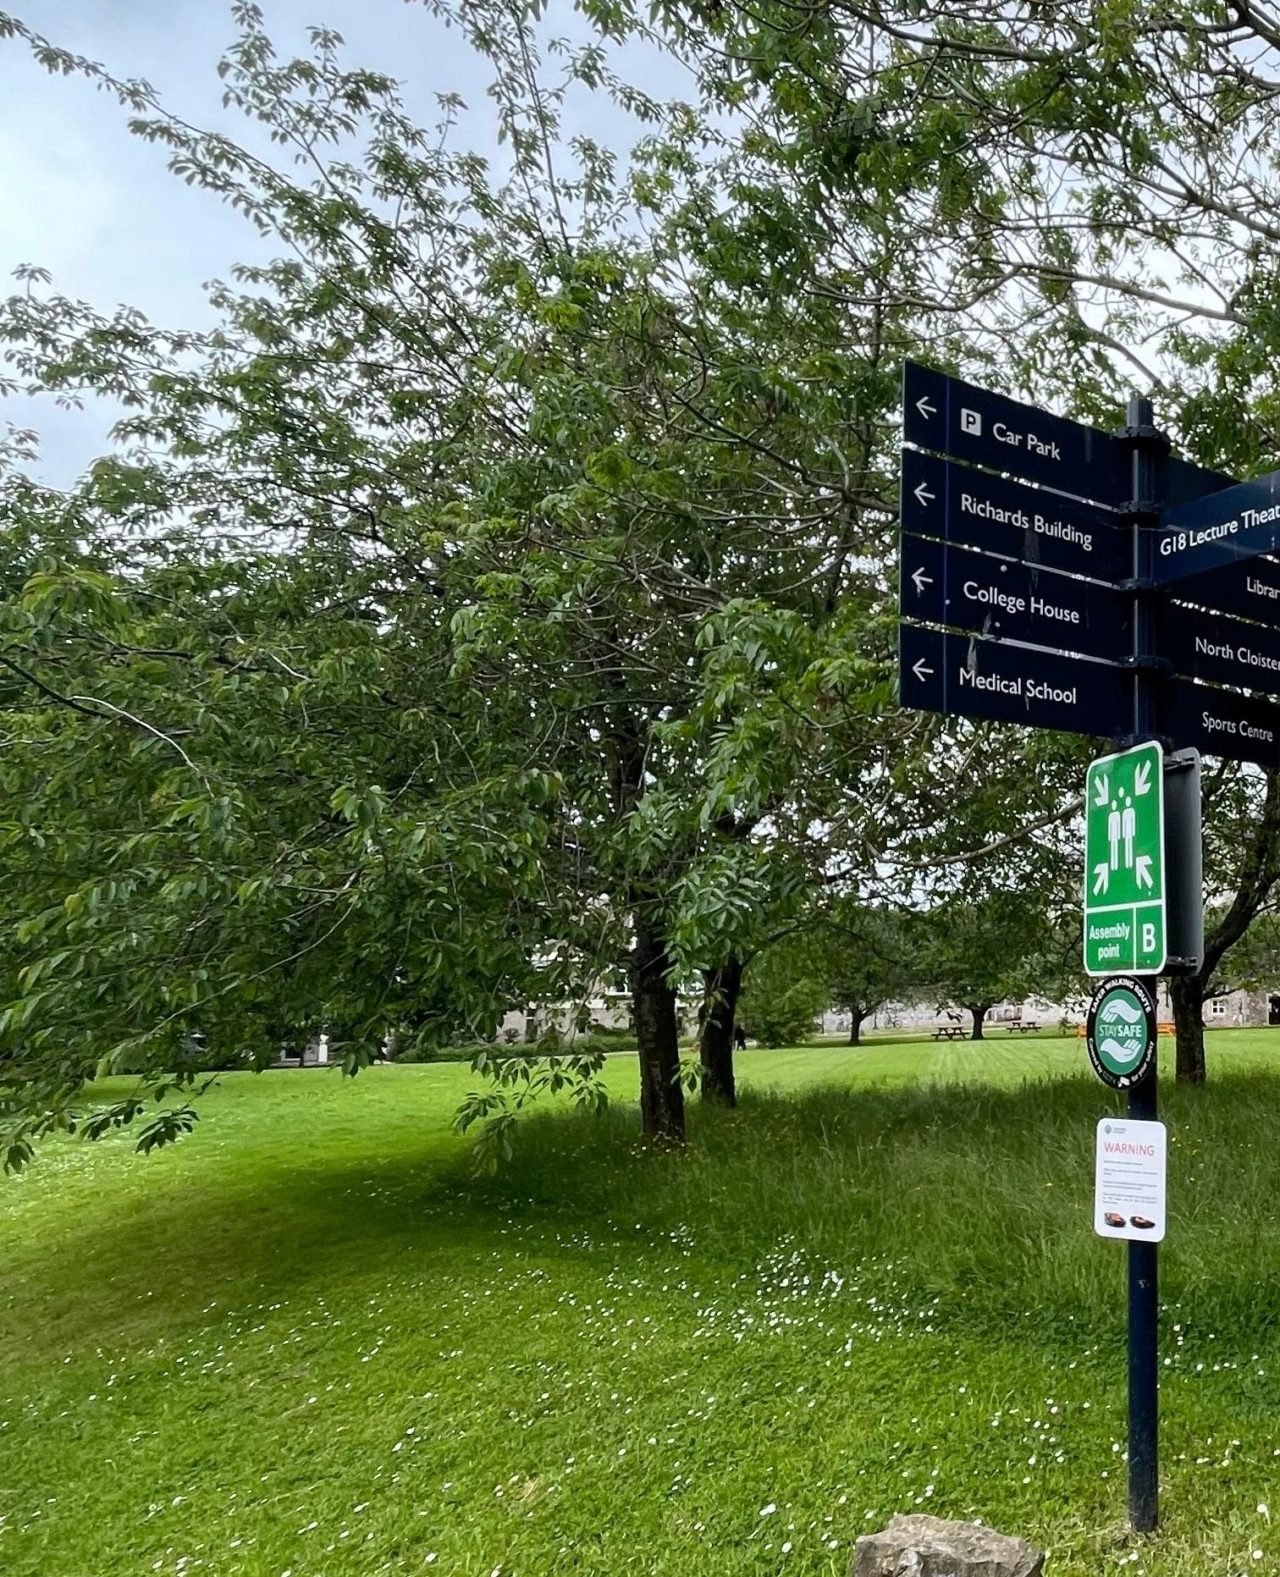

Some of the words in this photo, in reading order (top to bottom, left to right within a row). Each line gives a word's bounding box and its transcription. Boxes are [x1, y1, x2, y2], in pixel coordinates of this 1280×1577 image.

[992, 422, 1023, 446] Car
[1027, 433, 1062, 461] Park
[961, 493, 1029, 529] Richards
[1033, 514, 1093, 552] Building
[1189, 519, 1239, 548] Lecture
[963, 581, 1026, 614] College
[1030, 596, 1081, 624] House
[1195, 636, 1235, 661] North
[959, 667, 1022, 696] Medical
[1025, 679, 1077, 705] School
[1201, 710, 1237, 733] Sports
[1239, 719, 1274, 743] Centre
[1089, 922, 1131, 941] Assembly
[1142, 922, 1156, 953] B
[1097, 943, 1121, 962] point
[1104, 978, 1135, 991] WALKING
[1134, 984, 1152, 1014] ROUTE
[1103, 1142, 1155, 1156] WARNING
